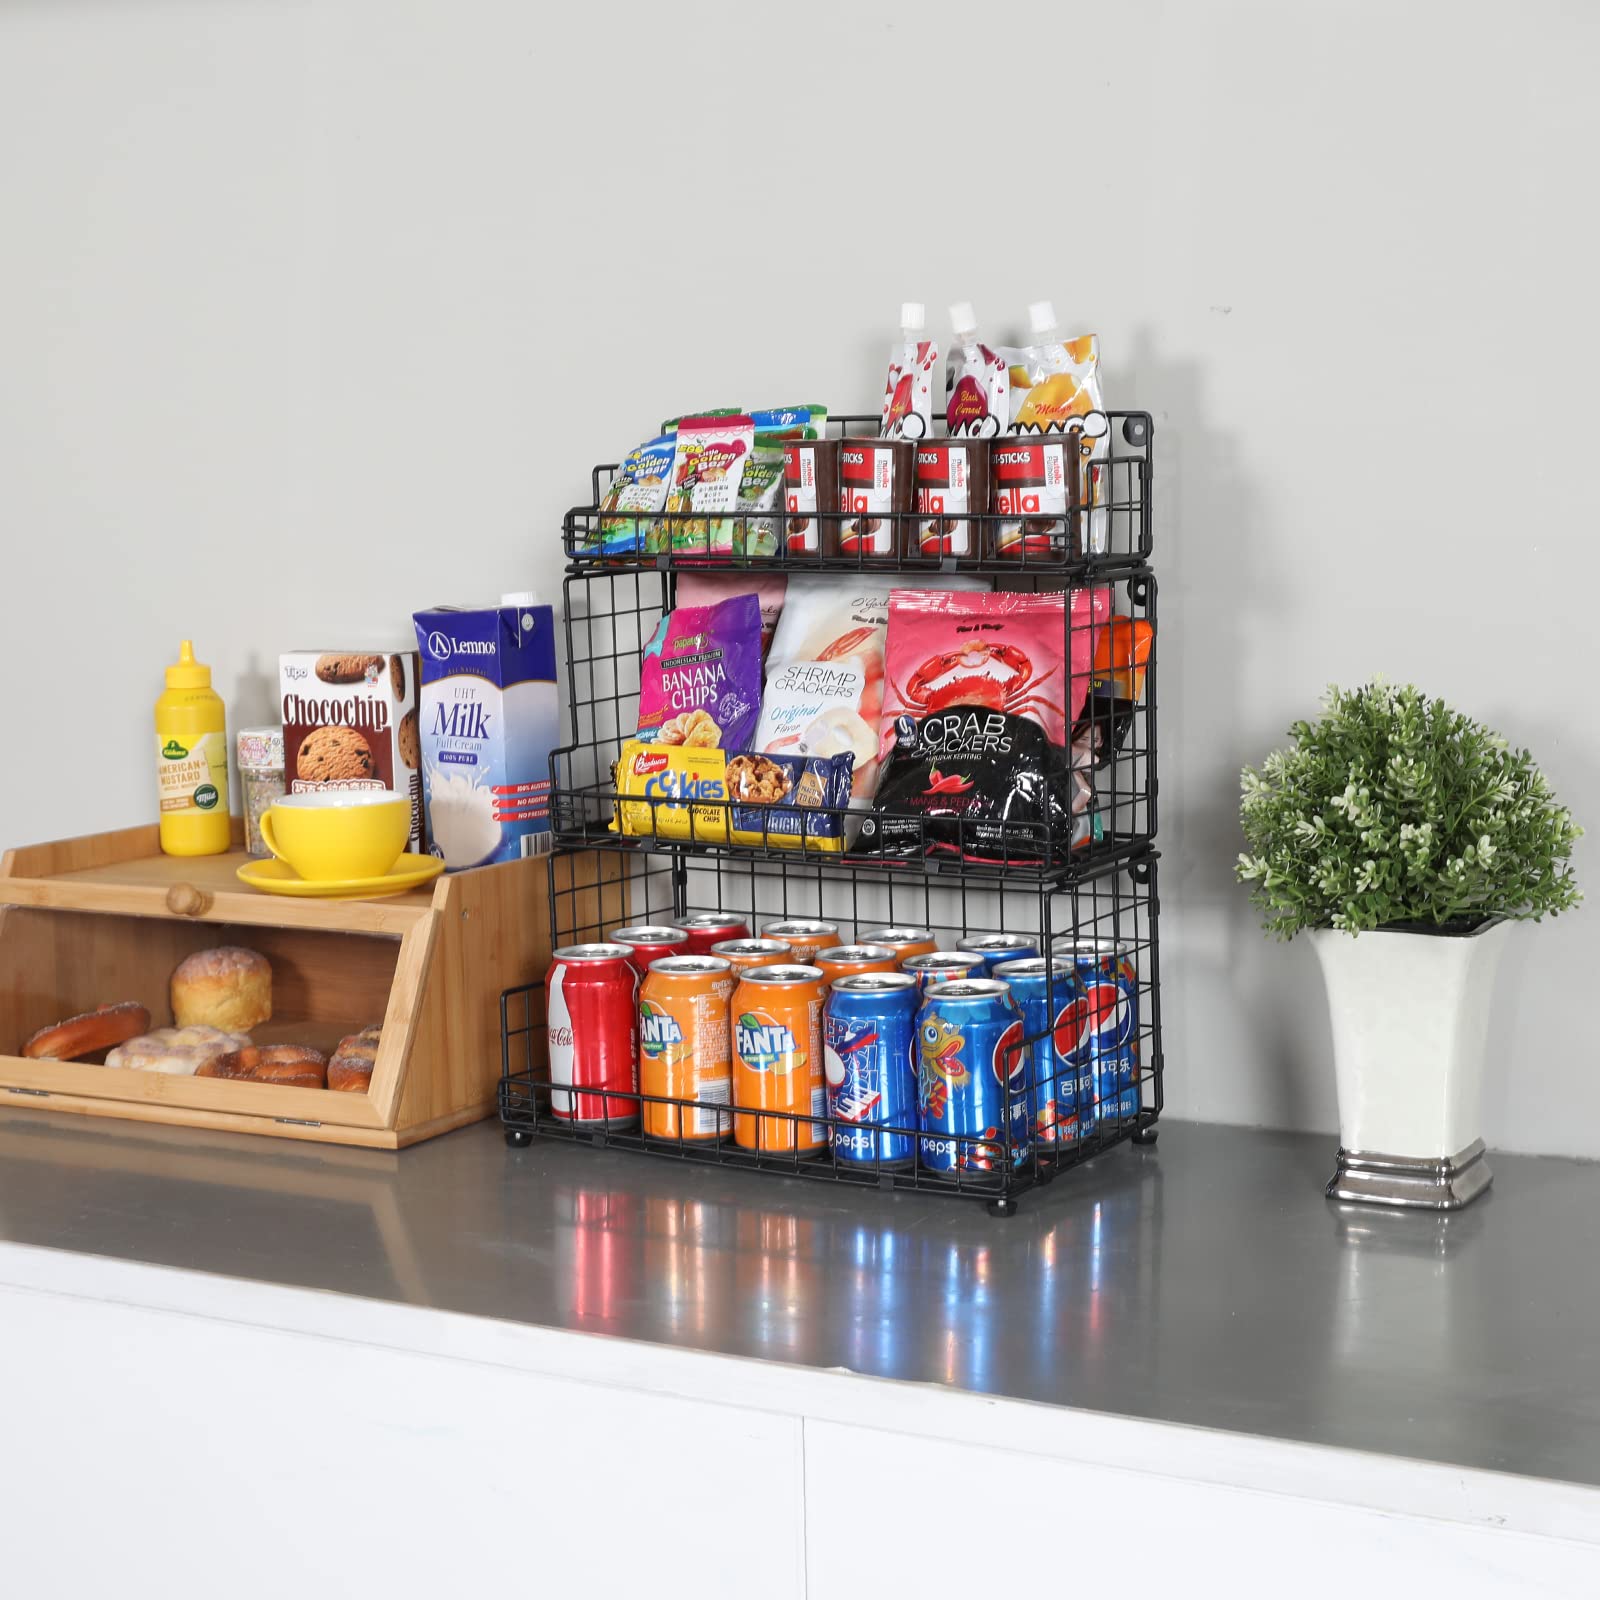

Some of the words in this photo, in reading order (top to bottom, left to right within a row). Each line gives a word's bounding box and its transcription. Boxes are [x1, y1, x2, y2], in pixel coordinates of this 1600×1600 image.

[960, 391, 978, 402] Black
[626, 457, 670, 473] Golden
[689, 453, 735, 466] Golden
[697, 460, 732, 472] Bea
[635, 464, 668, 477] Bear
[741, 477, 769, 488] Bea
[450, 637, 496, 654] Lemnos
[284, 665, 308, 680] Tipo
[662, 663, 727, 692] BANANA
[784, 666, 857, 686] SHRIMP
[454, 688, 476, 699] UHT
[775, 678, 855, 698] CRACKERS
[671, 684, 718, 709] CHIPS
[283, 693, 388, 730] Chocochip
[770, 702, 823, 724] Original
[431, 702, 491, 739] Milk
[774, 723, 801, 735] Flavor
[923, 712, 1007, 745] CRAB
[436, 737, 452, 749] Full
[454, 739, 482, 751] Cream
[911, 734, 1013, 759] CRACKERS
[443, 753, 457, 761] 100%
[160, 771, 200, 785] MUSTARD
[196, 791, 216, 803] Mild
[703, 815, 721, 823] CHIPS
[735, 1025, 796, 1054] FANTA
[922, 1137, 957, 1156] peps
